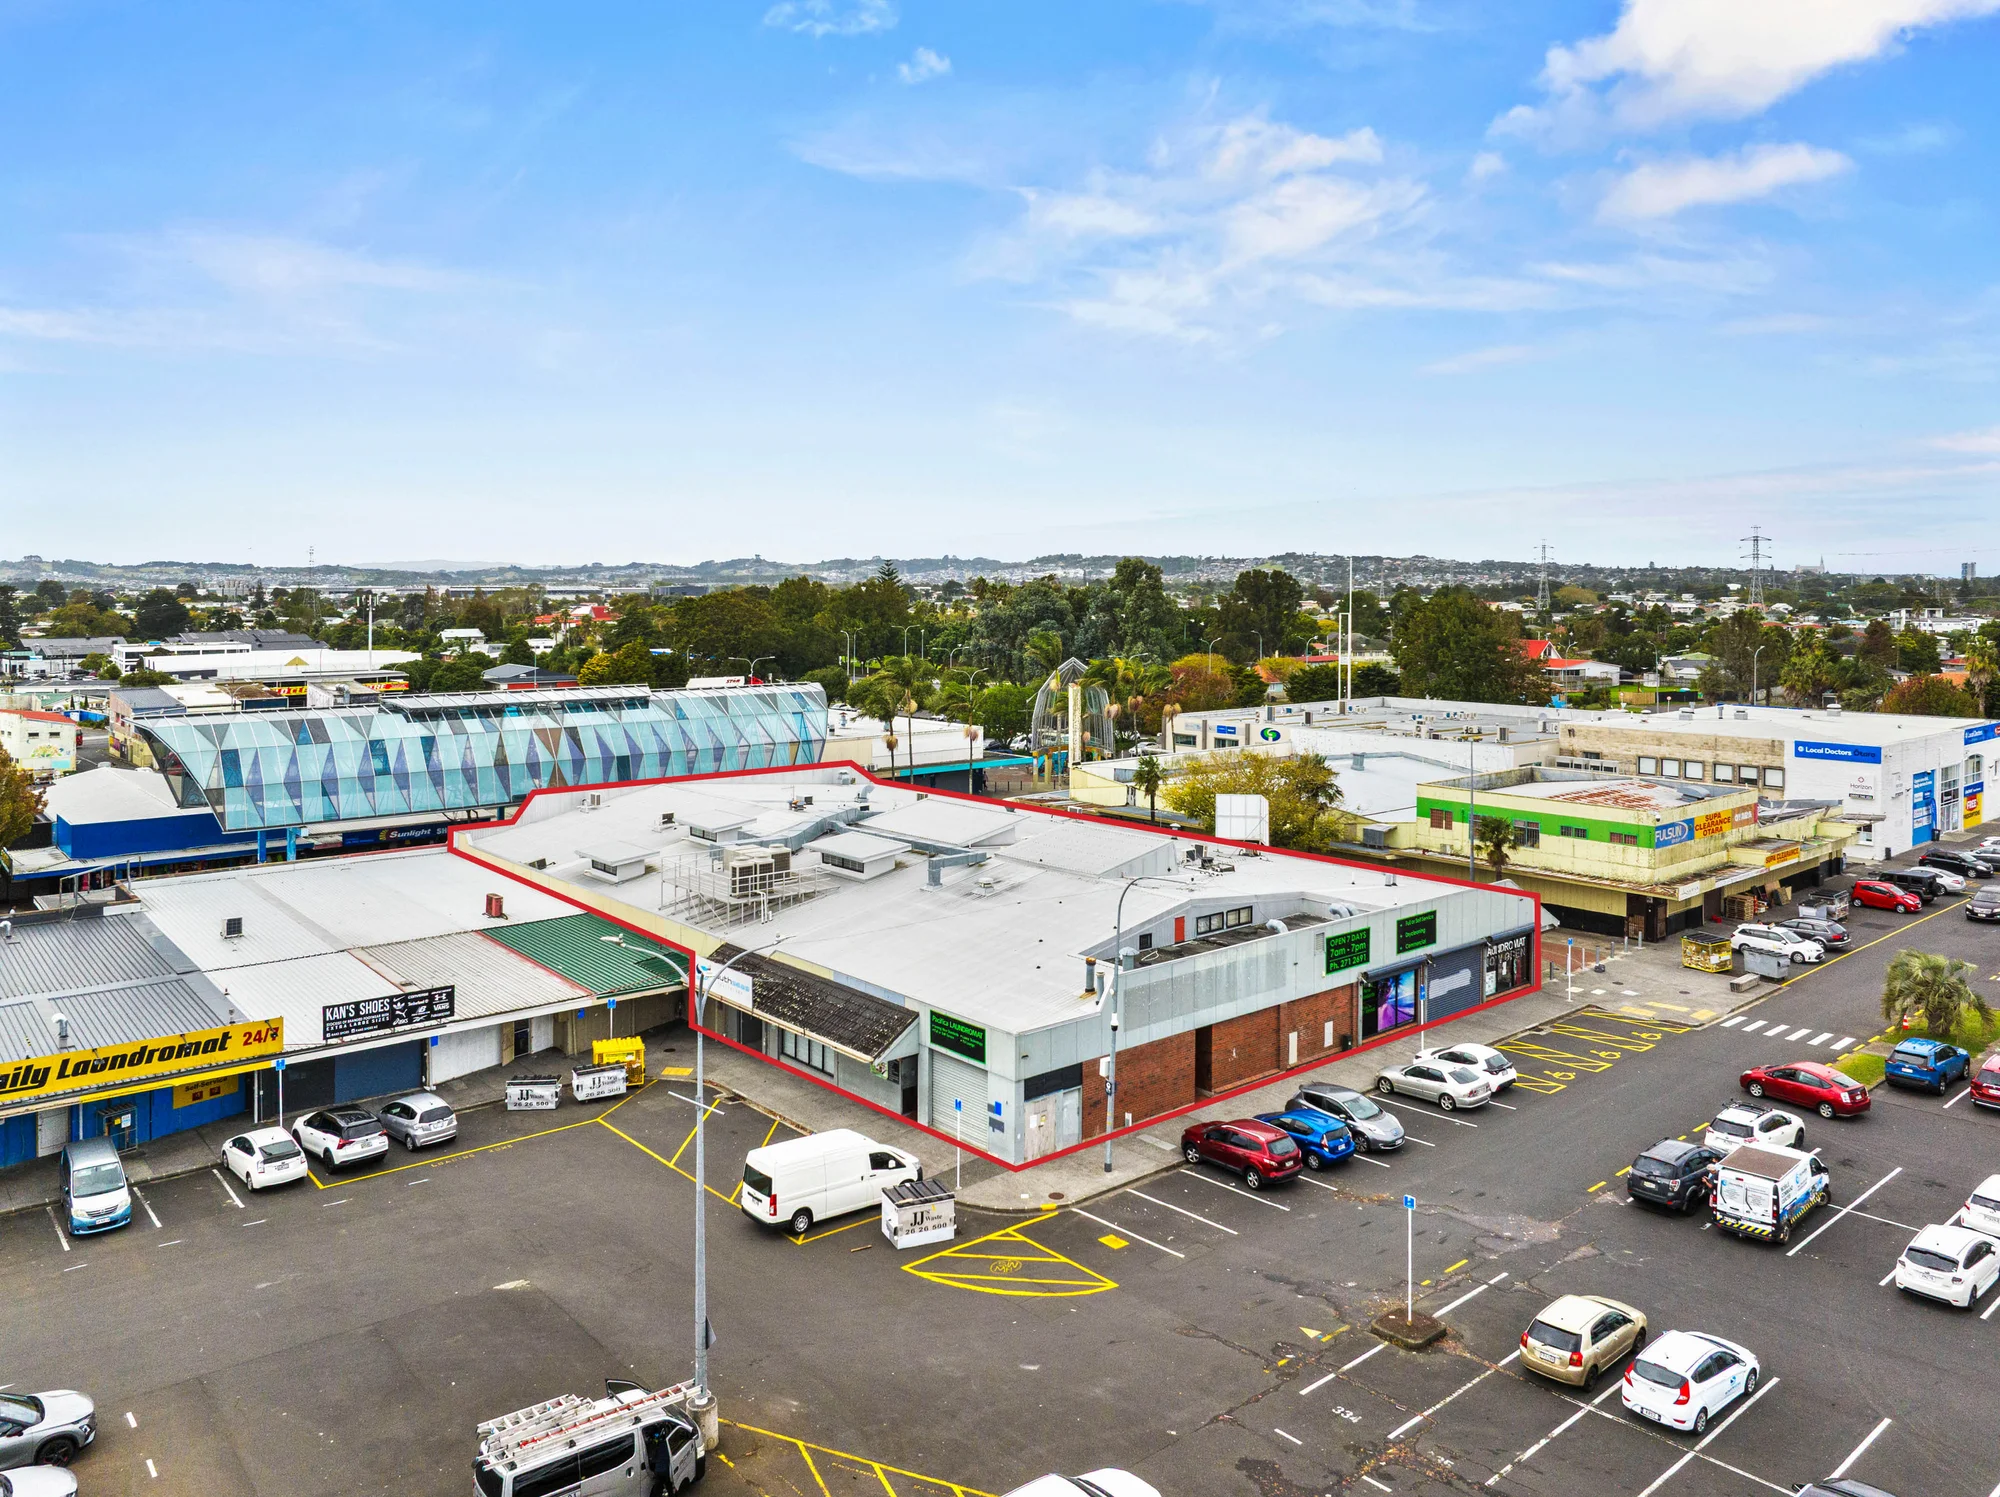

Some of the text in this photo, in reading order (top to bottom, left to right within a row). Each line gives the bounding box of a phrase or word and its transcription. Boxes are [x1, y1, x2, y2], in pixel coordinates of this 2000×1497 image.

[1825, 748, 1852, 756] Doctors
[1694, 816, 1731, 831] CLEARANCE
[1705, 812, 1721, 822] SUPA
[389, 828, 431, 839] Sunlight
[1655, 826, 1682, 842] FULSUN
[1702, 826, 1723, 836] OTARA
[1765, 848, 1798, 864] SUPA CLEARANCE
[1330, 937, 1346, 947] OPEN
[1351, 931, 1367, 941] DAYS
[1330, 948, 1346, 957] 7am
[1351, 942, 1367, 952] 7pm
[1330, 953, 1367, 970] Ph. 271 2691
[325, 998, 390, 1021] KAN'S SHOES
[433, 1002, 450, 1011] VANS
[949, 1021, 983, 1039] LAUNDROMAT
[56, 1031, 232, 1080] Laundromat
[242, 1026, 280, 1047] 24/7
[185, 1076, 228, 1092] Self-Service
[430, 1153, 476, 1168] LOADING
[918, 1225, 929, 1233] 26
[932, 1222, 947, 1230] 500
[1332, 1406, 1362, 1423] 334
